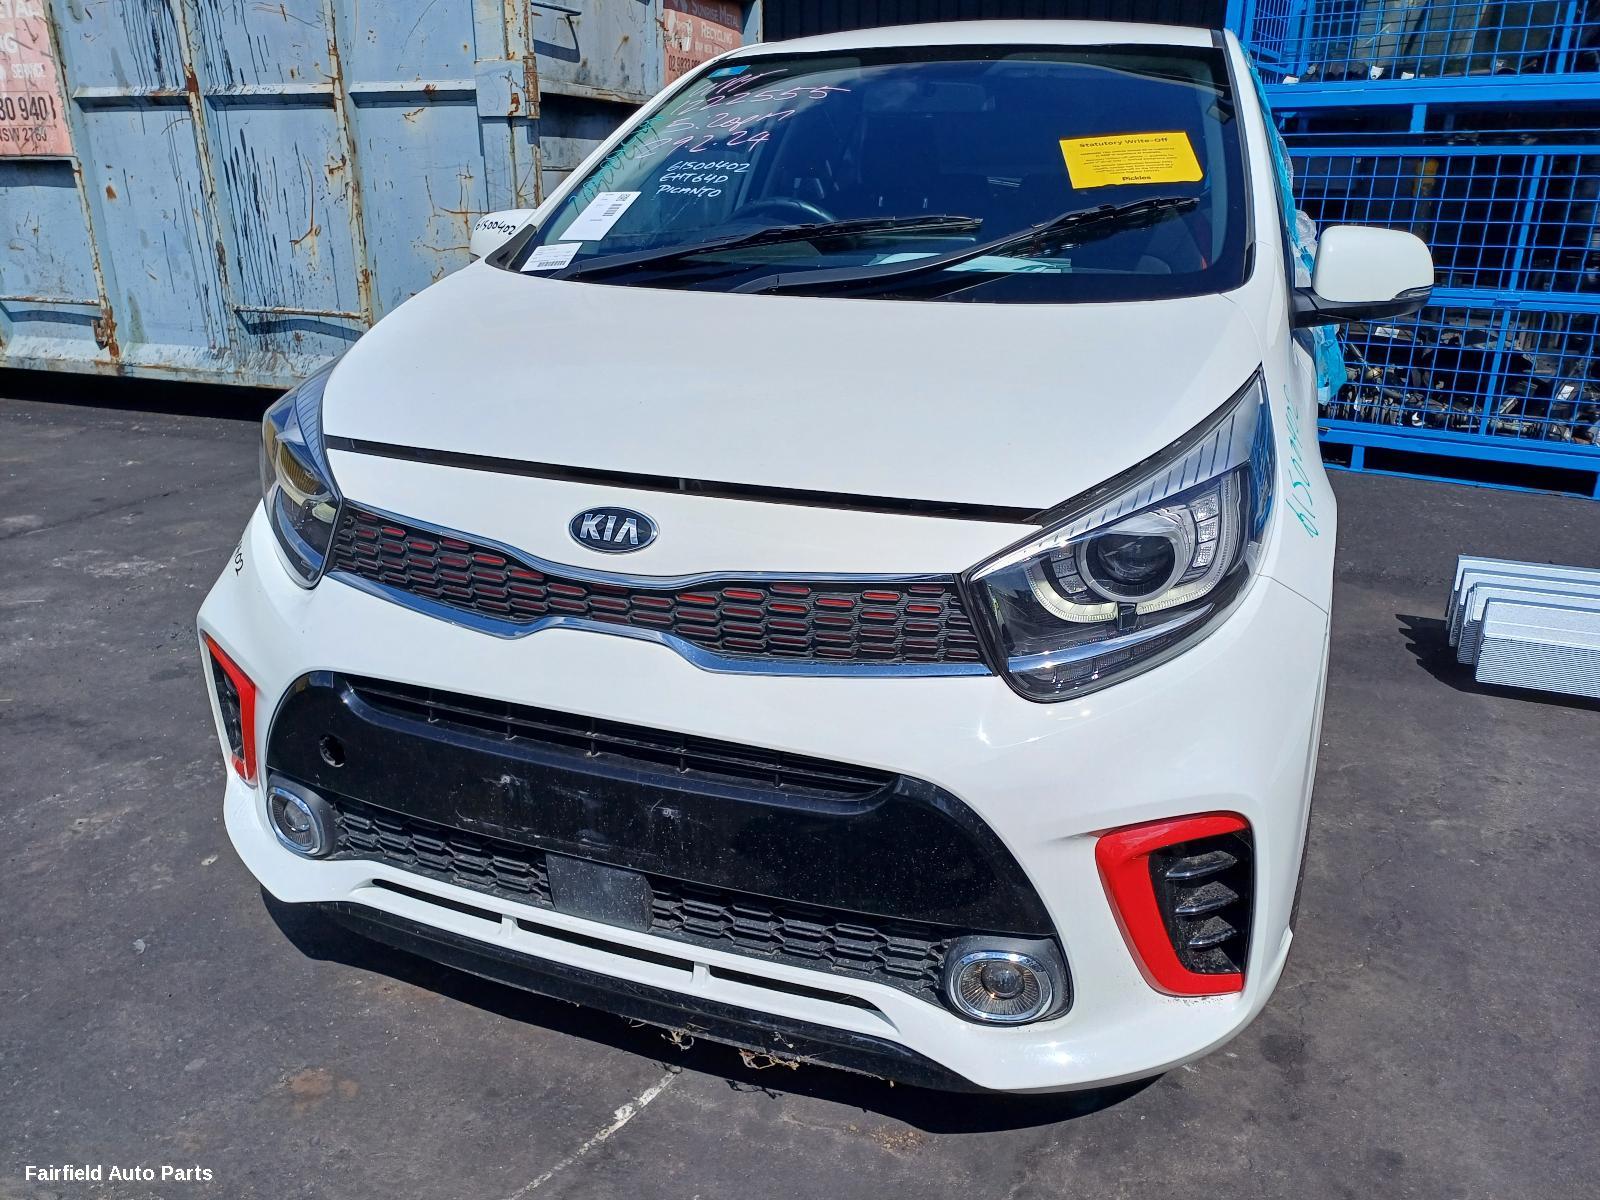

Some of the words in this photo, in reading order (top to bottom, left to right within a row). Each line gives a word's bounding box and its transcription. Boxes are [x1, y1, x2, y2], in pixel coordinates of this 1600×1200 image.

[666, 160, 751, 173] 61500402
[656, 184, 722, 197] PICANTO
[579, 513, 639, 545] KIA
